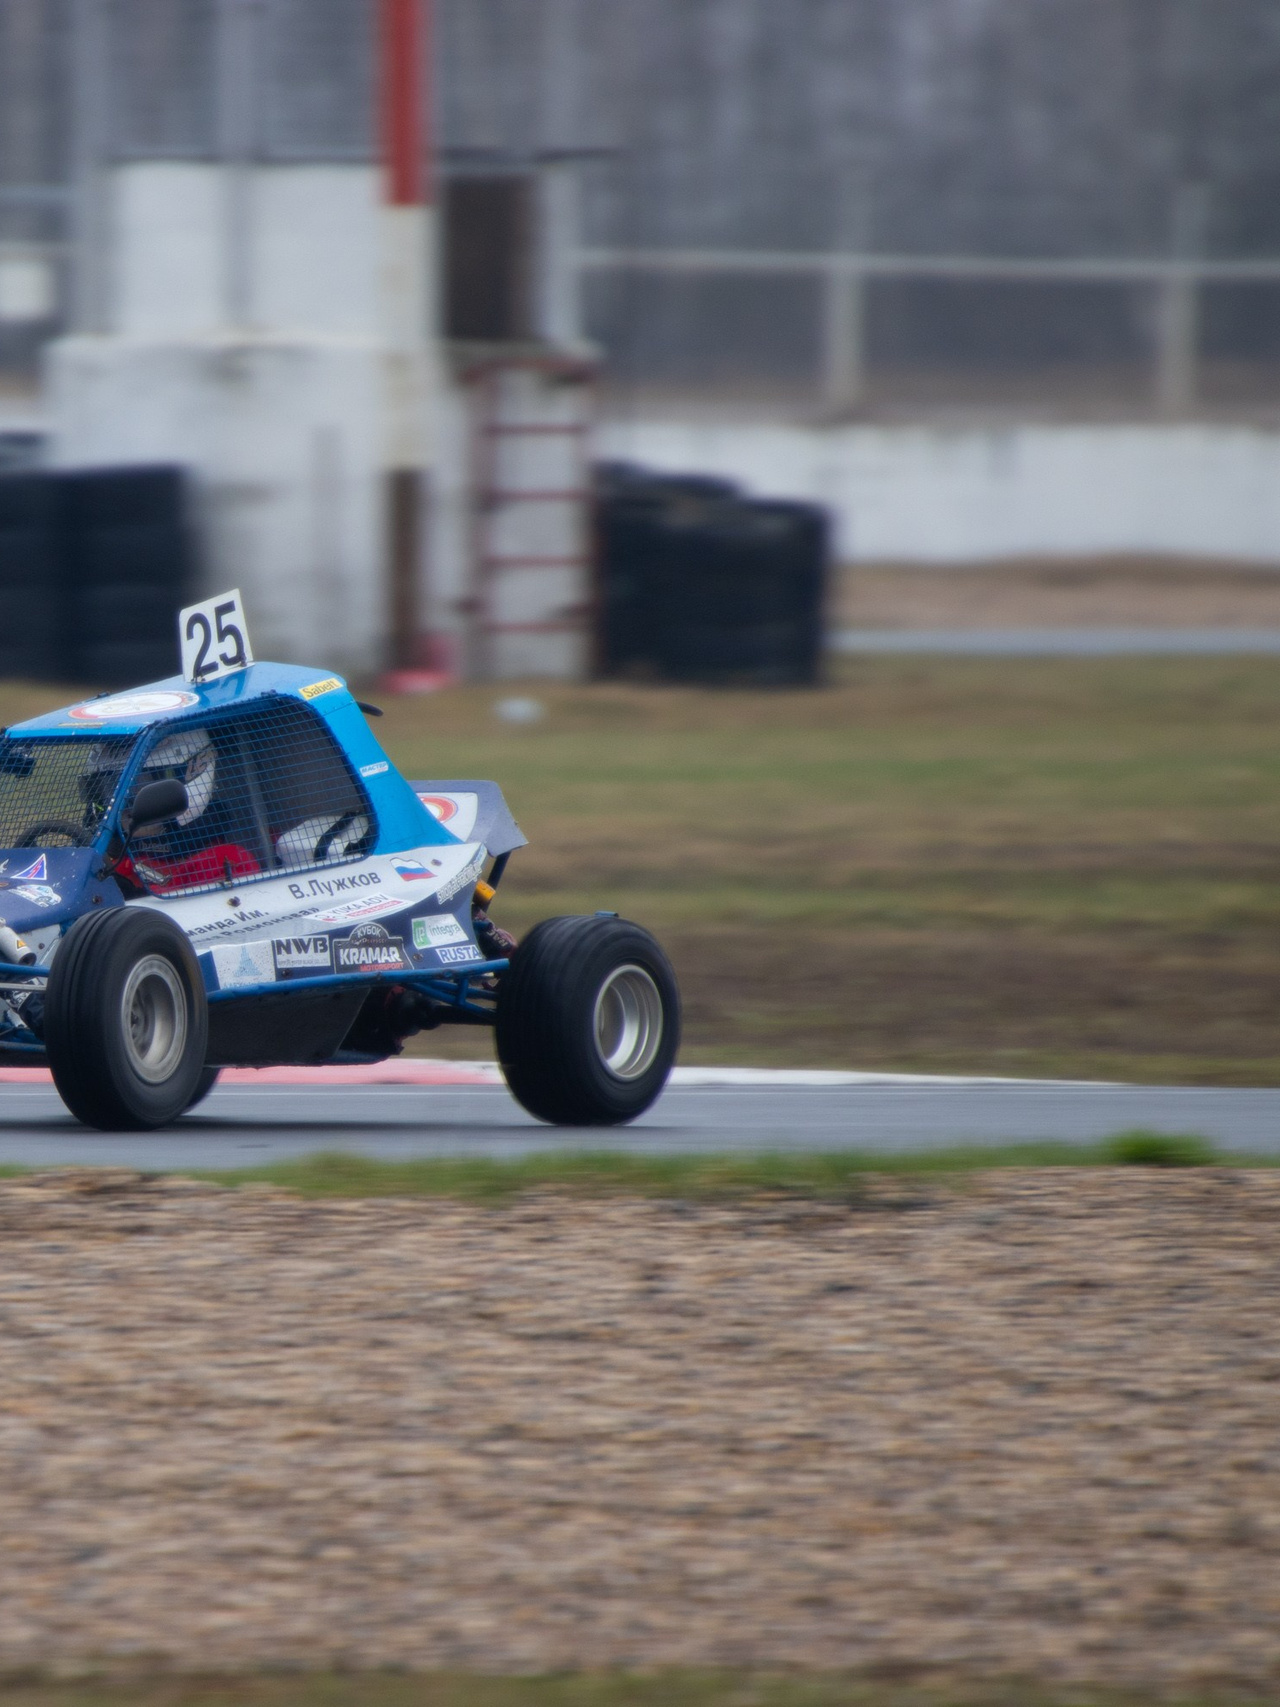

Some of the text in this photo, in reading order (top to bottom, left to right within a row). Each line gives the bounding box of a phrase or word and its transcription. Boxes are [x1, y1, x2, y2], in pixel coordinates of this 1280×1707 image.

[186, 600, 245, 680] 25
[302, 680, 338, 698] Sabelt
[288, 872, 382, 899] В.Лужков
[186, 909, 269, 938] манда Им.
[357, 925, 381, 938] КУБОК
[429, 923, 461, 937] integra
[276, 937, 328, 955] NWB
[340, 947, 402, 965] KRAMAR
